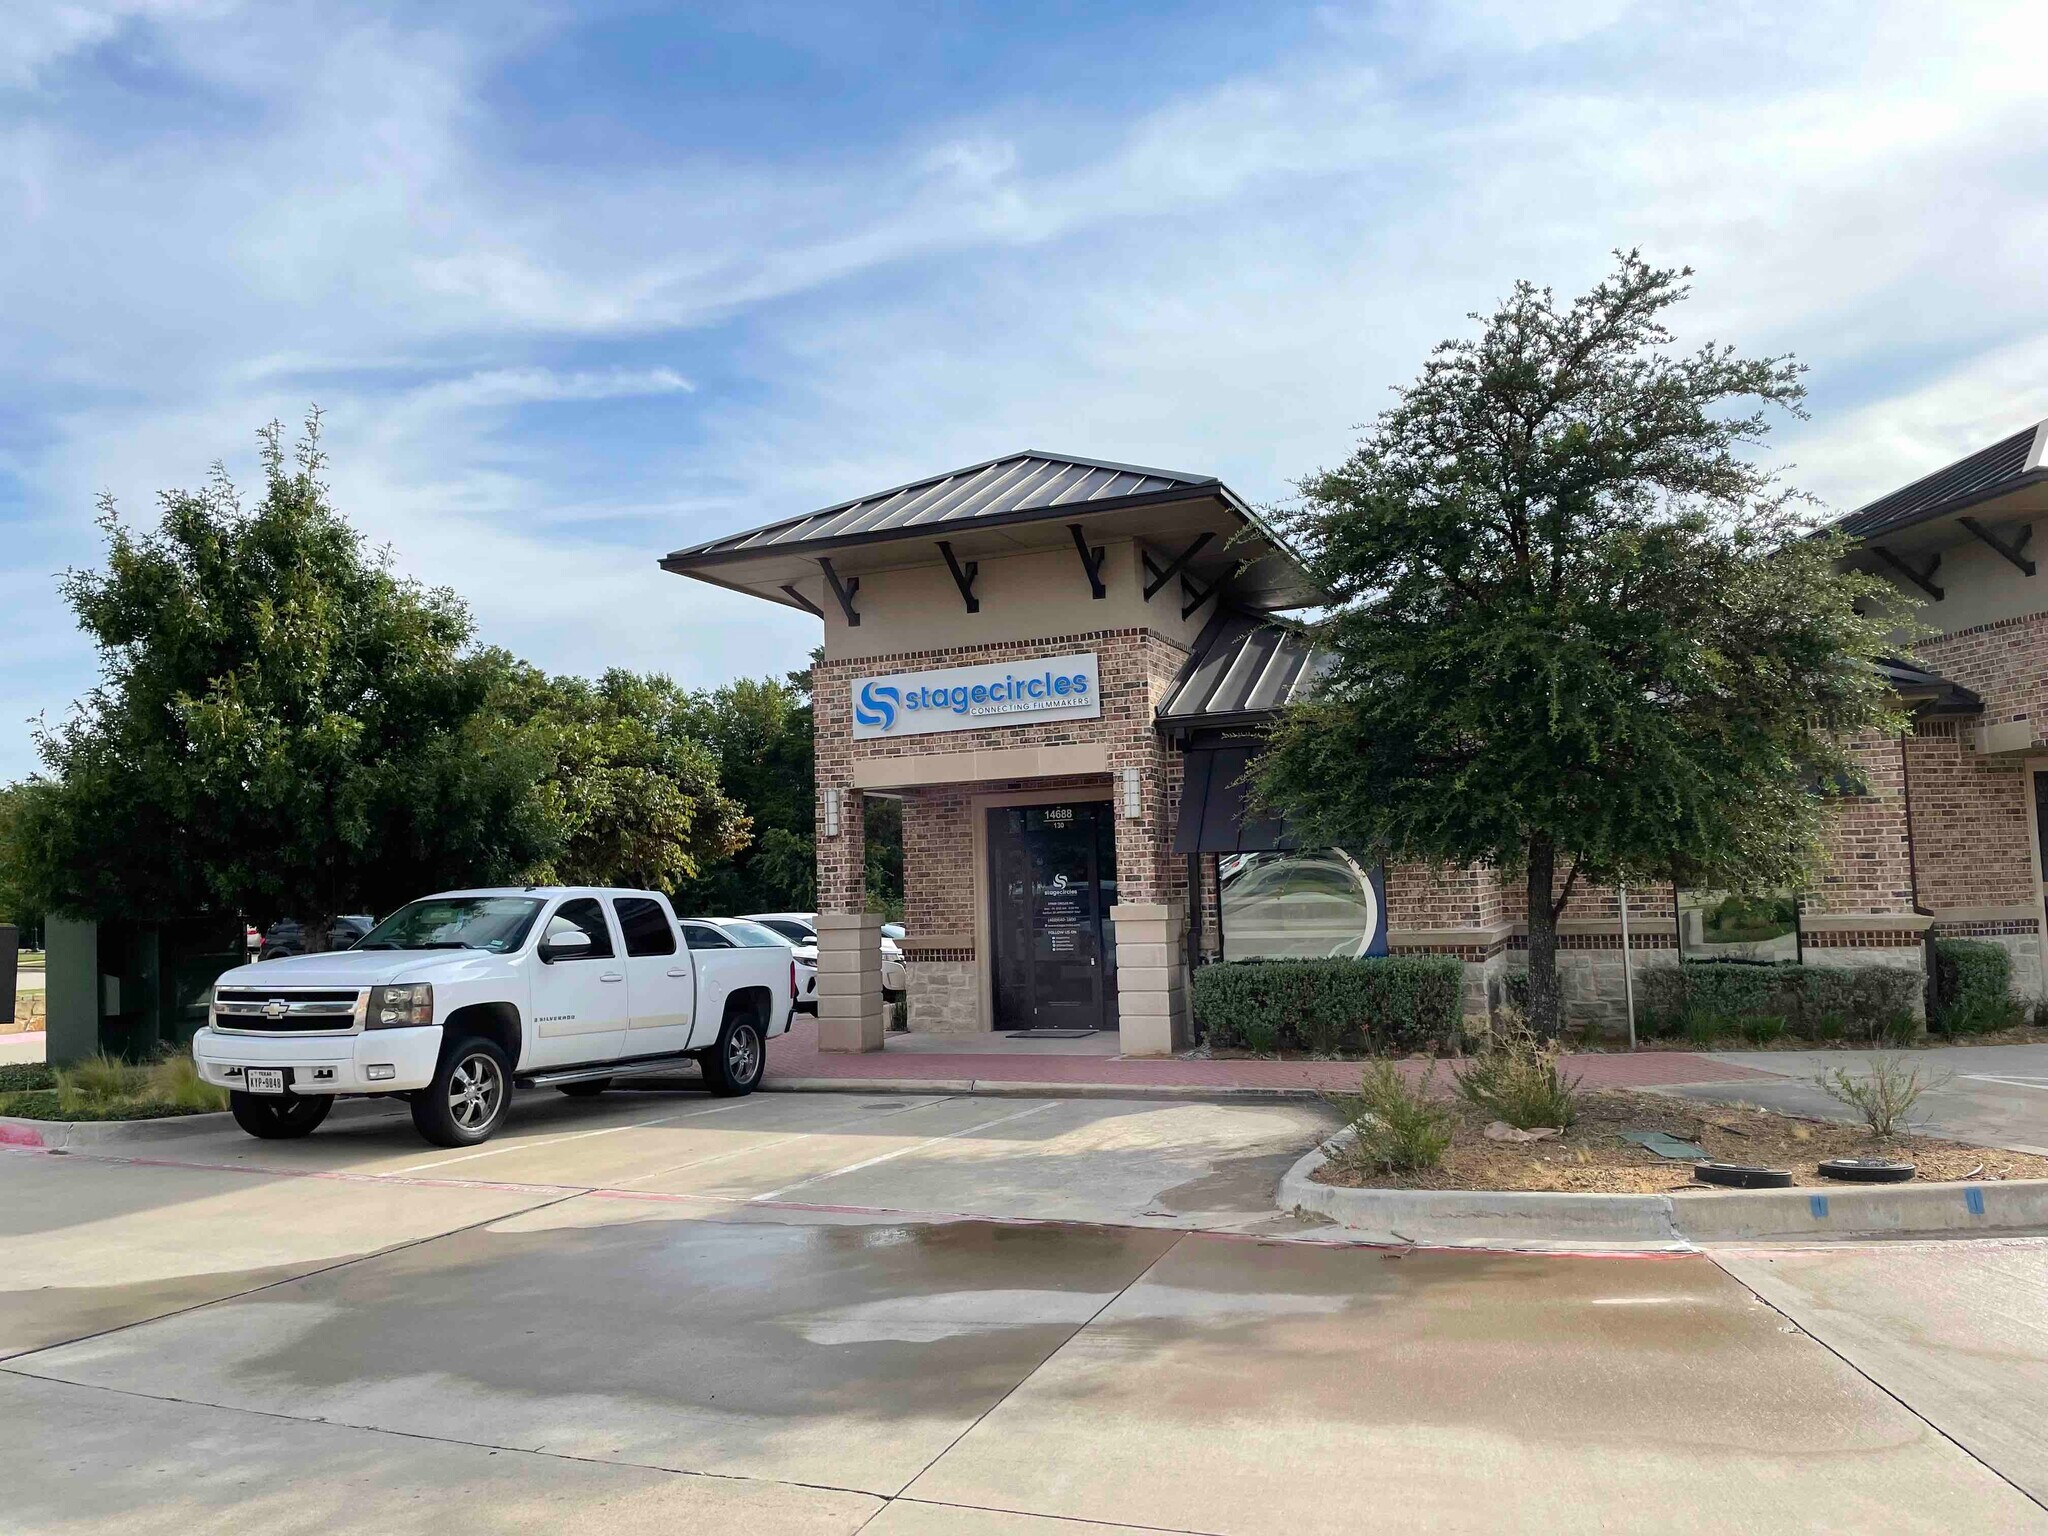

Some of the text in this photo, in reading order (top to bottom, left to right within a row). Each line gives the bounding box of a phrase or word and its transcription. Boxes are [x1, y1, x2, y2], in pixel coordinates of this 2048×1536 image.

[905, 672, 1089, 714] stagecircles
[970, 697, 1089, 715] CONNECTING FILMMAKERS
[1044, 809, 1073, 819] 14688
